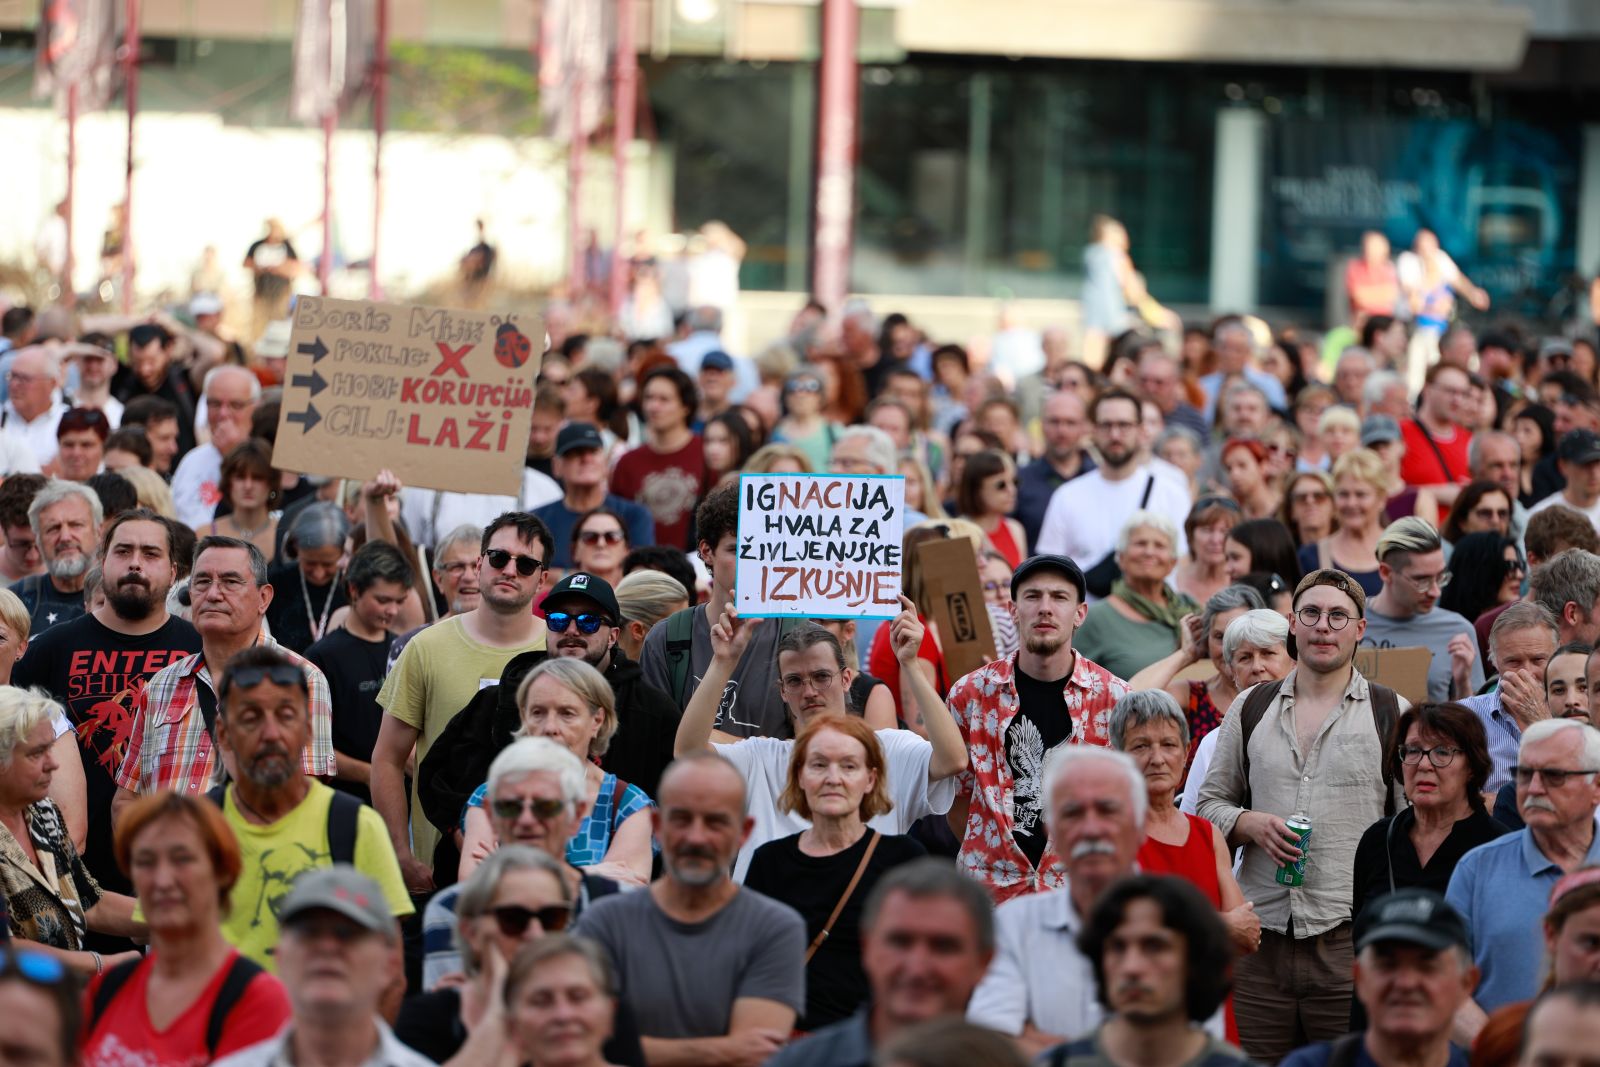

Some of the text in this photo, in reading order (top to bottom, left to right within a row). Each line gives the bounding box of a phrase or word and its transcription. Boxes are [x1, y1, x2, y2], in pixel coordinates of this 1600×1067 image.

[324, 404, 405, 441] CILJ:
[746, 481, 895, 521] IGNACIJA,
[765, 514, 881, 539] HVALA ZA
[739, 535, 902, 566] ŽIVLJENJSKE
[760, 562, 901, 607] IZKUŠNJE
